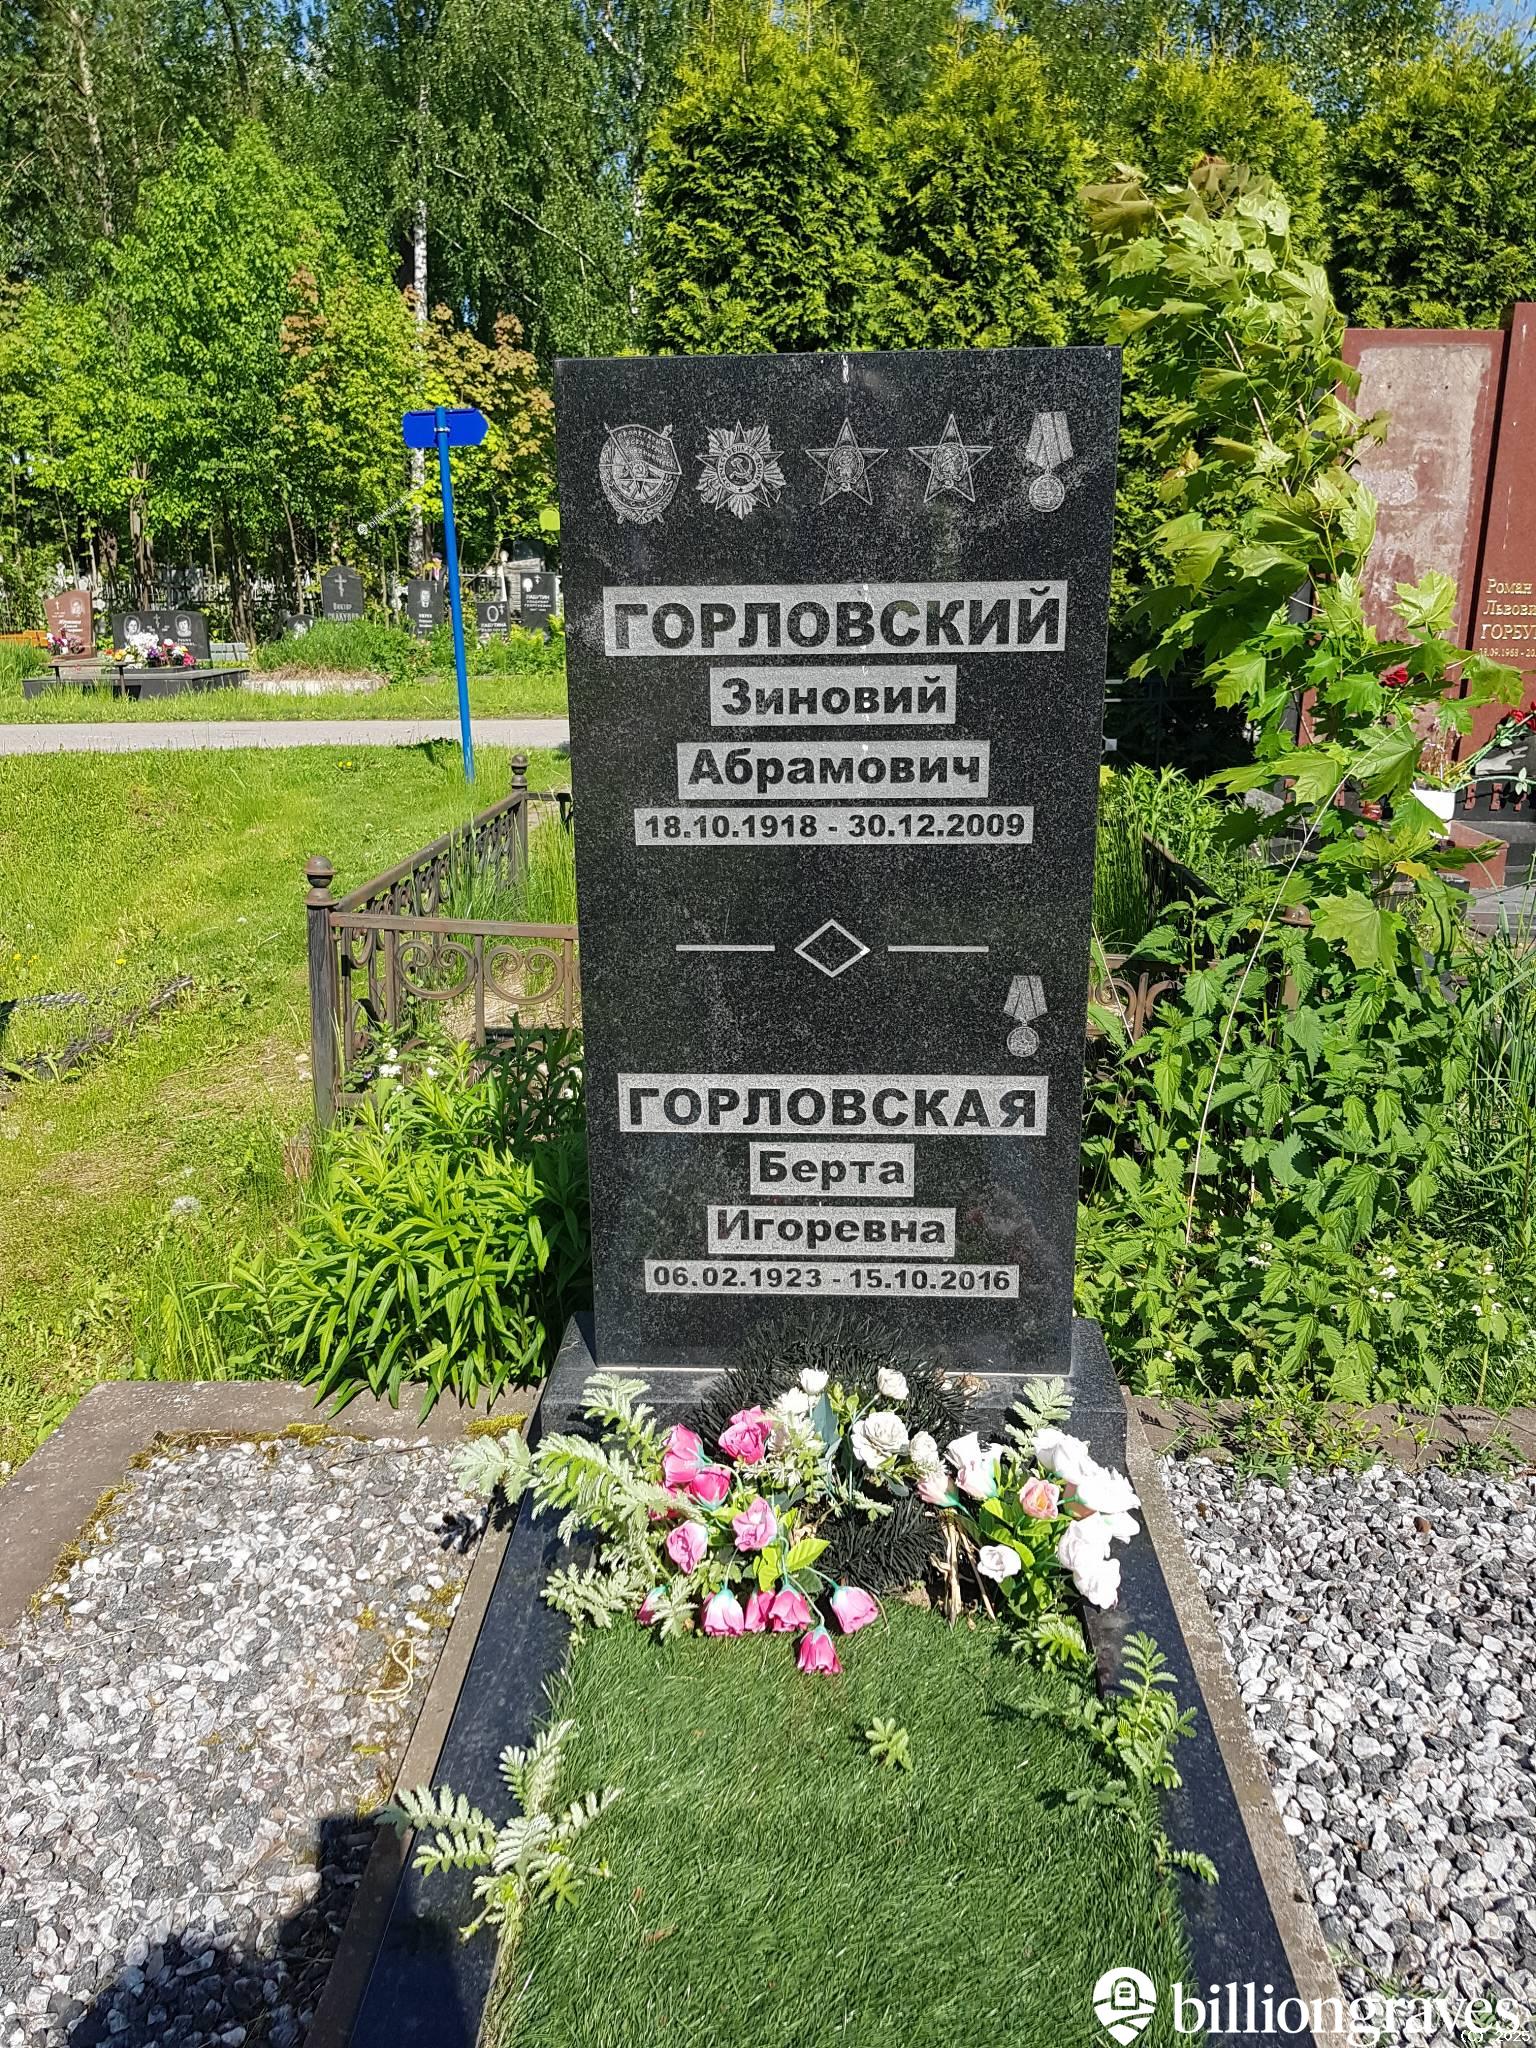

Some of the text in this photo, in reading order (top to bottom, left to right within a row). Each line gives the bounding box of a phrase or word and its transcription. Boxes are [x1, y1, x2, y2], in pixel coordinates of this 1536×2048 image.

[1485, 578, 1533, 594] Роман
[614, 586, 1062, 650] ГОРЛОВСКИЙ
[721, 676, 946, 716] Зиновий
[688, 748, 981, 793] Абрамович
[645, 814, 817, 839] 18.10.1918
[848, 813, 1025, 838] 30.12.2009
[628, 1088, 1036, 1128] ГОРЛОВСКАЯ
[758, 1150, 905, 1190] Берта
[717, 1210, 946, 1249] Игоревна
[653, 1265, 822, 1287] 06.02.1923
[850, 1269, 1010, 1291] 15.10.2016
